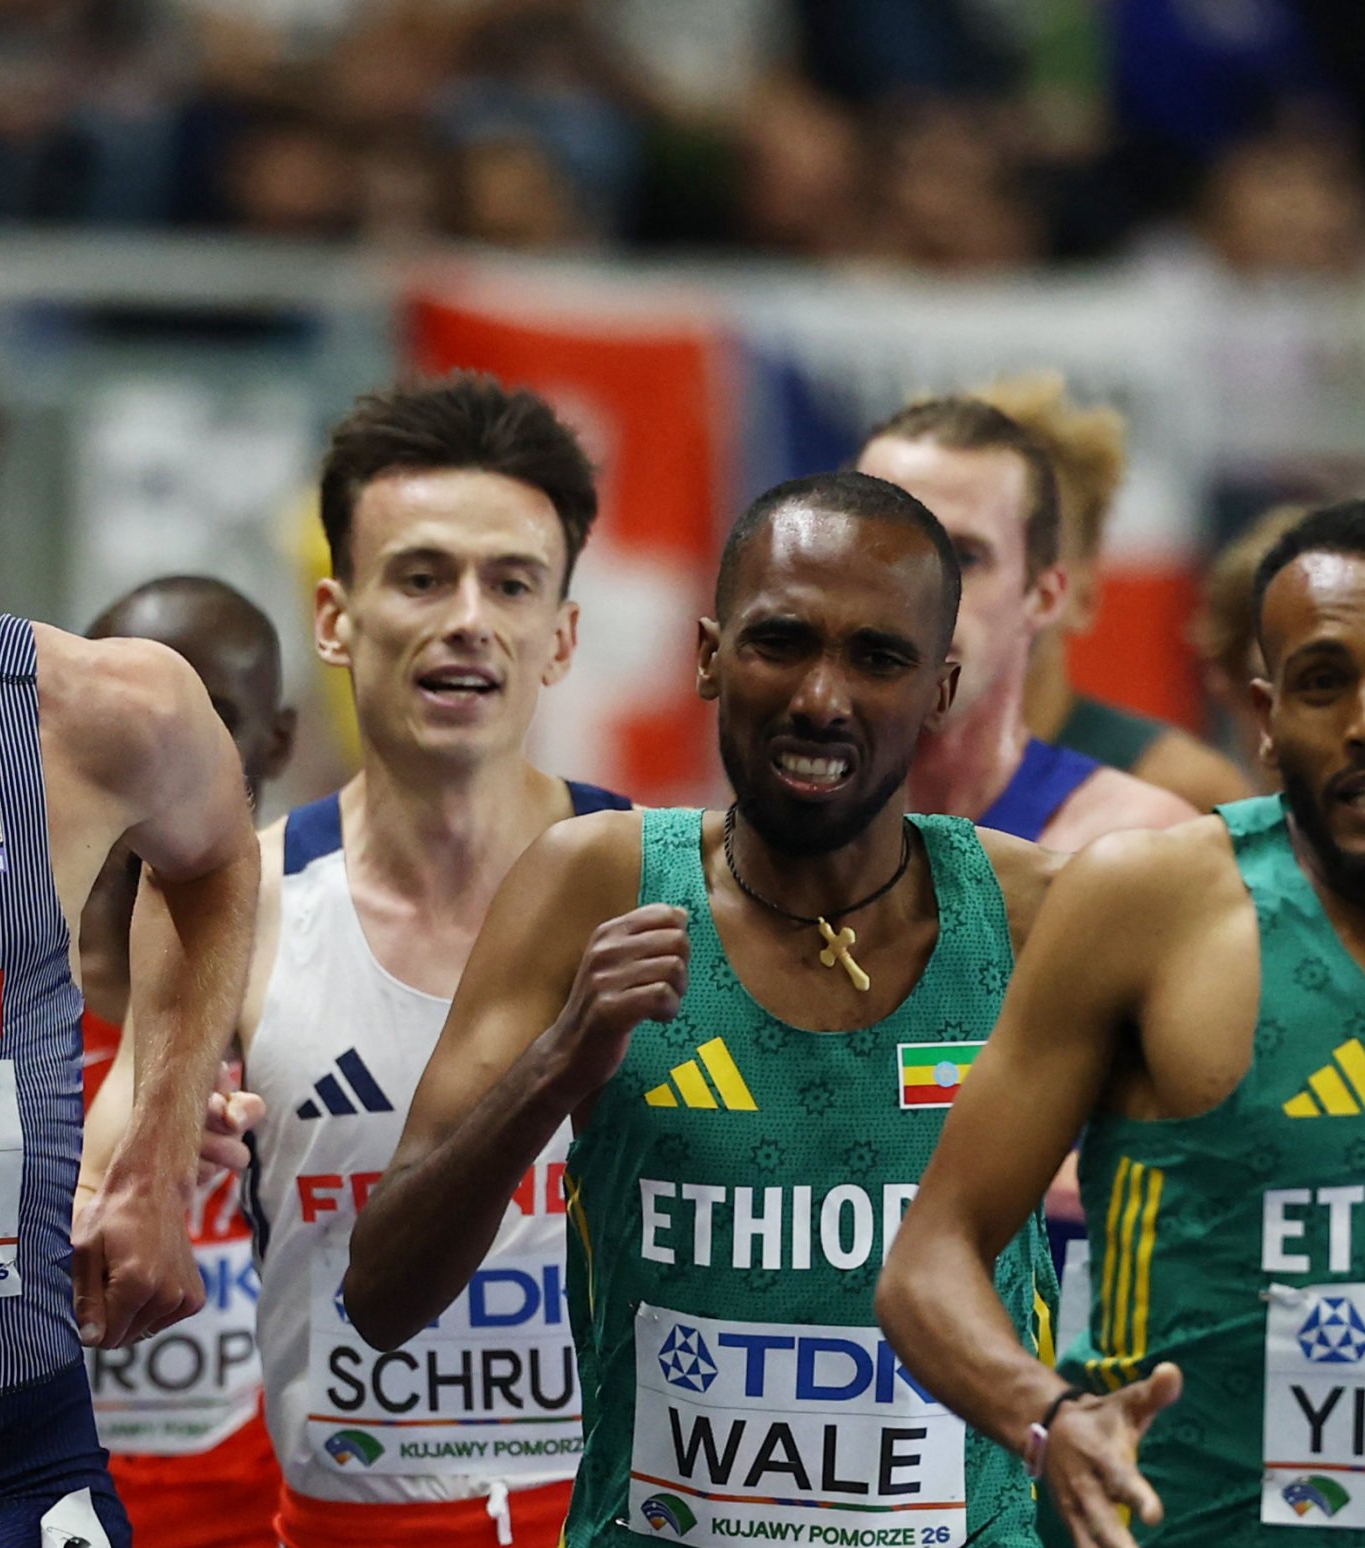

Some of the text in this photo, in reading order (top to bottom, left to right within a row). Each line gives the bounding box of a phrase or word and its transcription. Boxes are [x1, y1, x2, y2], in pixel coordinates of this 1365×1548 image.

[399, 1440, 488, 1459] KUJAWY
[668, 1406, 928, 1496] WALE
[711, 1517, 951, 1547] KUJAWY POMORZE 26
